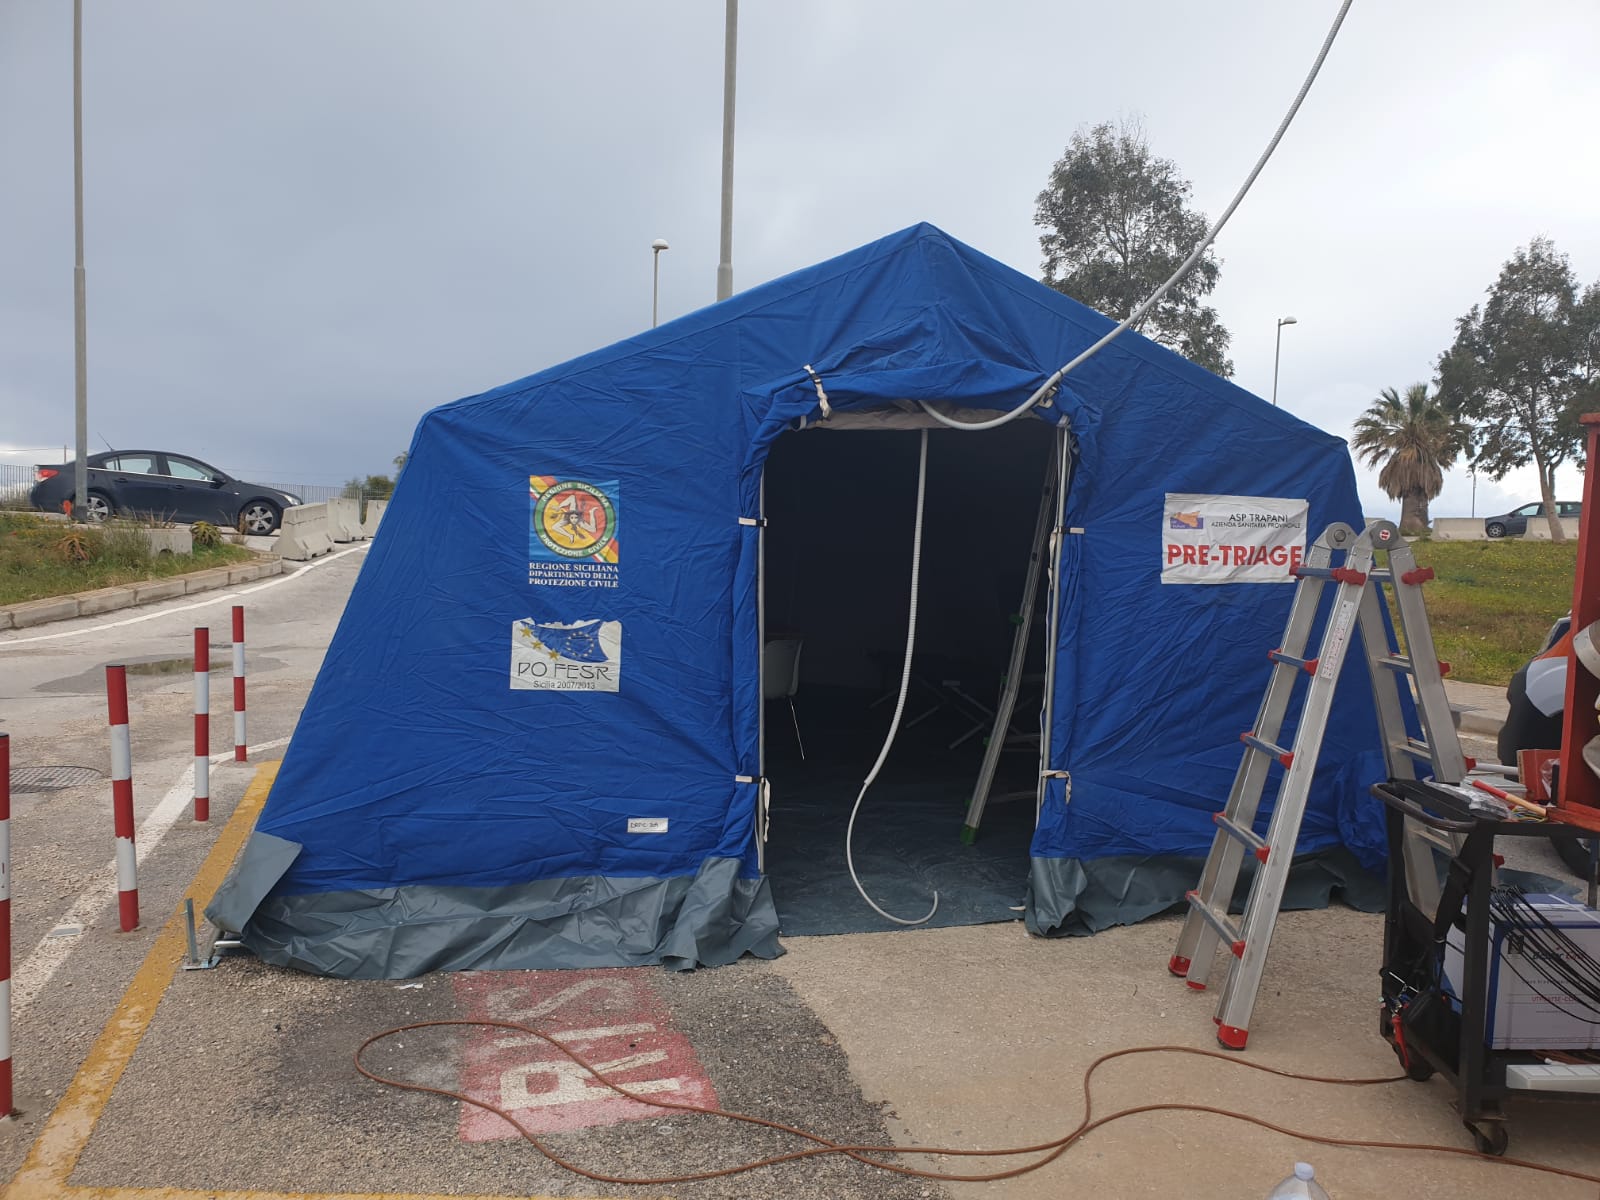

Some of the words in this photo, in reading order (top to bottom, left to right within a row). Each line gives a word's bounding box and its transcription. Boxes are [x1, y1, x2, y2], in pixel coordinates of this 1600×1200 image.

[1229, 513, 1247, 522] ASP
[1250, 513, 1288, 523] TRAPANI
[1167, 544, 1303, 567] PRE-TRIAGE
[529, 562, 571, 571] REGIONE
[573, 564, 619, 573] SICILIANA
[529, 571, 591, 579] DIPARTIMENTO
[529, 578, 587, 587] PROTEZIONE
[588, 580, 619, 588] CIVILE
[518, 661, 547, 677] PO
[554, 663, 612, 681] FESR
[533, 680, 555, 689] Sicilia
[557, 681, 595, 690] 2007/2013
